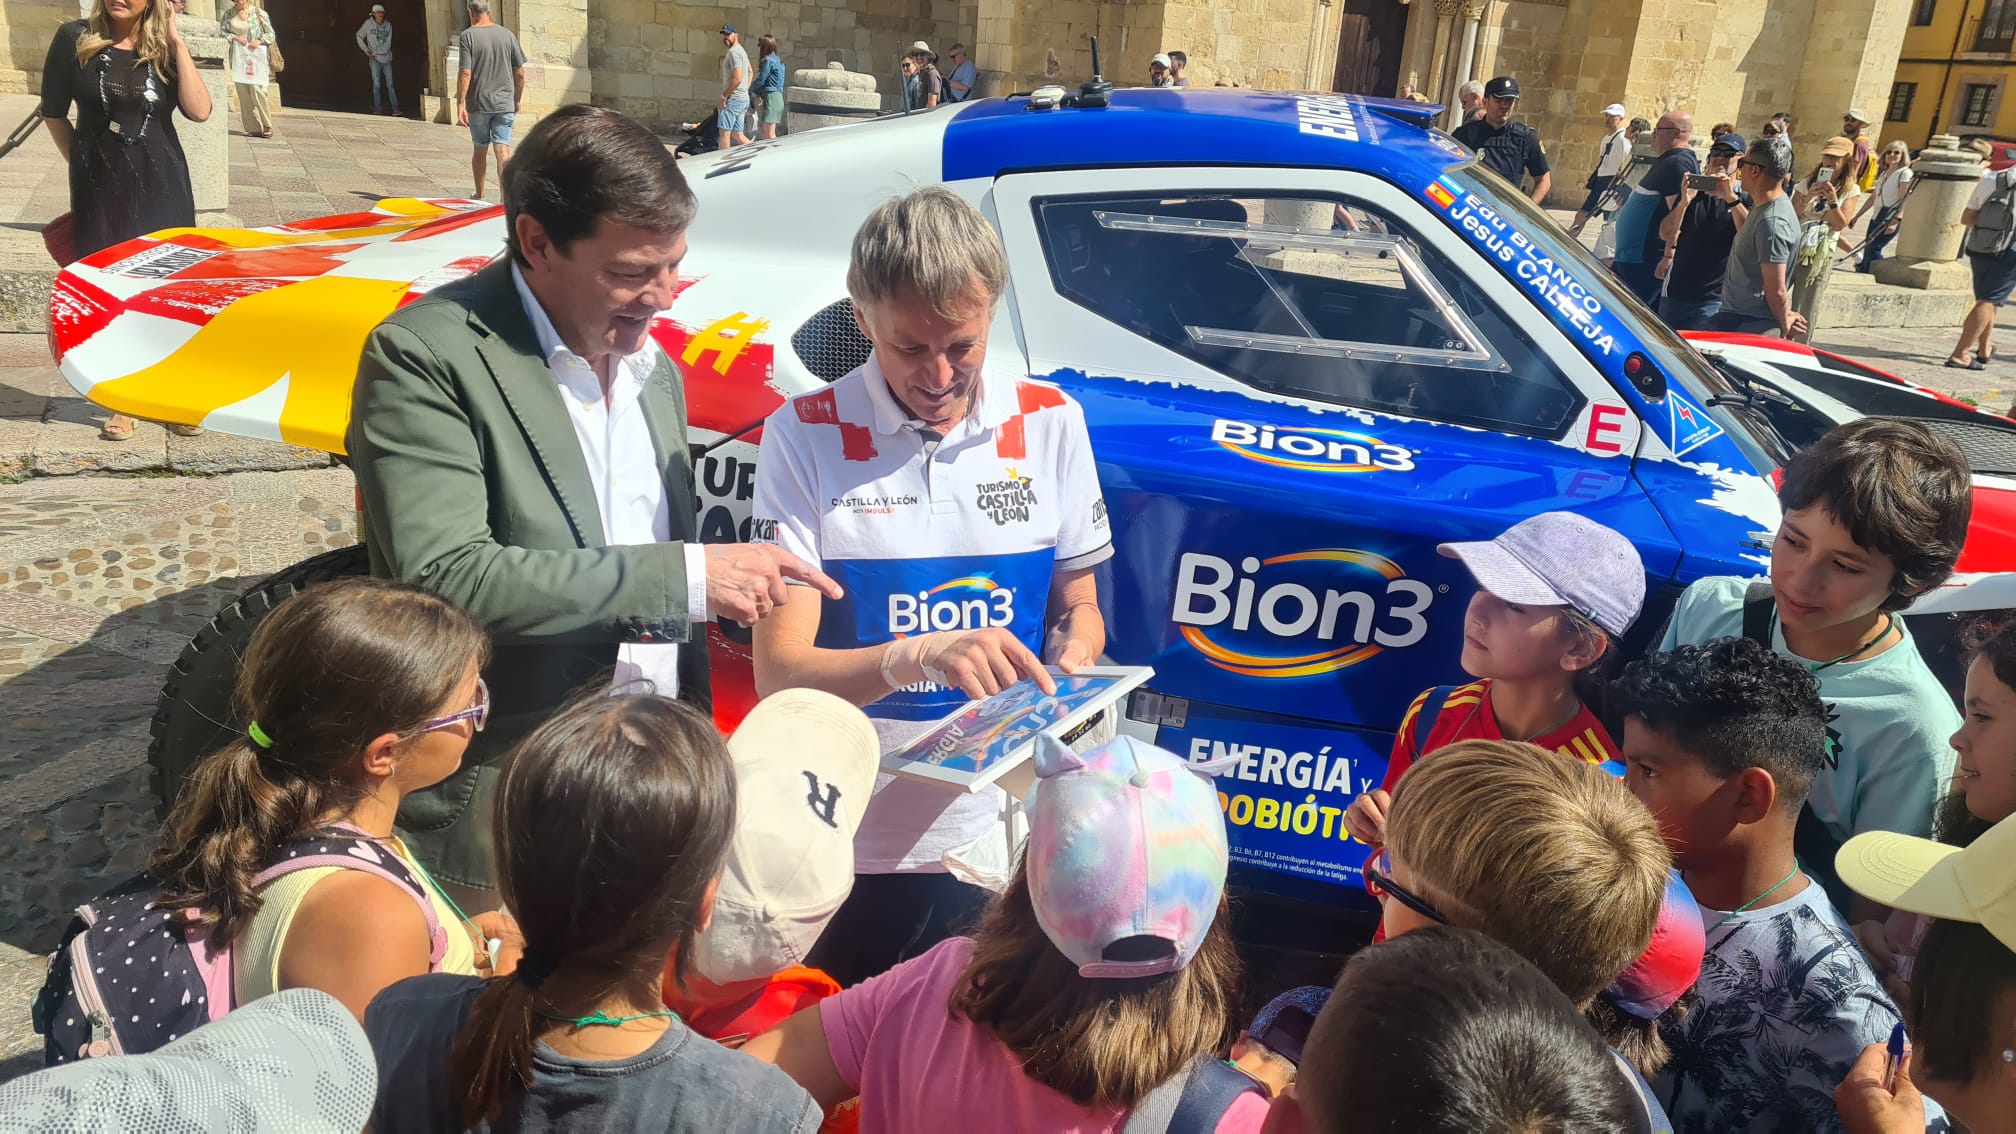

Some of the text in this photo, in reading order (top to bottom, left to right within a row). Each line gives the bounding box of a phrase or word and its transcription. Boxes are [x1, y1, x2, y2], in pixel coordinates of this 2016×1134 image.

[1465, 194, 1601, 314] Edu BLANCO
[1516, 260, 1616, 355] CALLEJA
[1211, 419, 1415, 471] Bion3
[1585, 403, 1627, 453] E
[831, 494, 918, 507] CASTILLA Y LEÓN
[976, 480, 1020, 494] TURISMO
[888, 588, 1014, 633] Bion3
[1171, 552, 1434, 647] Bion3
